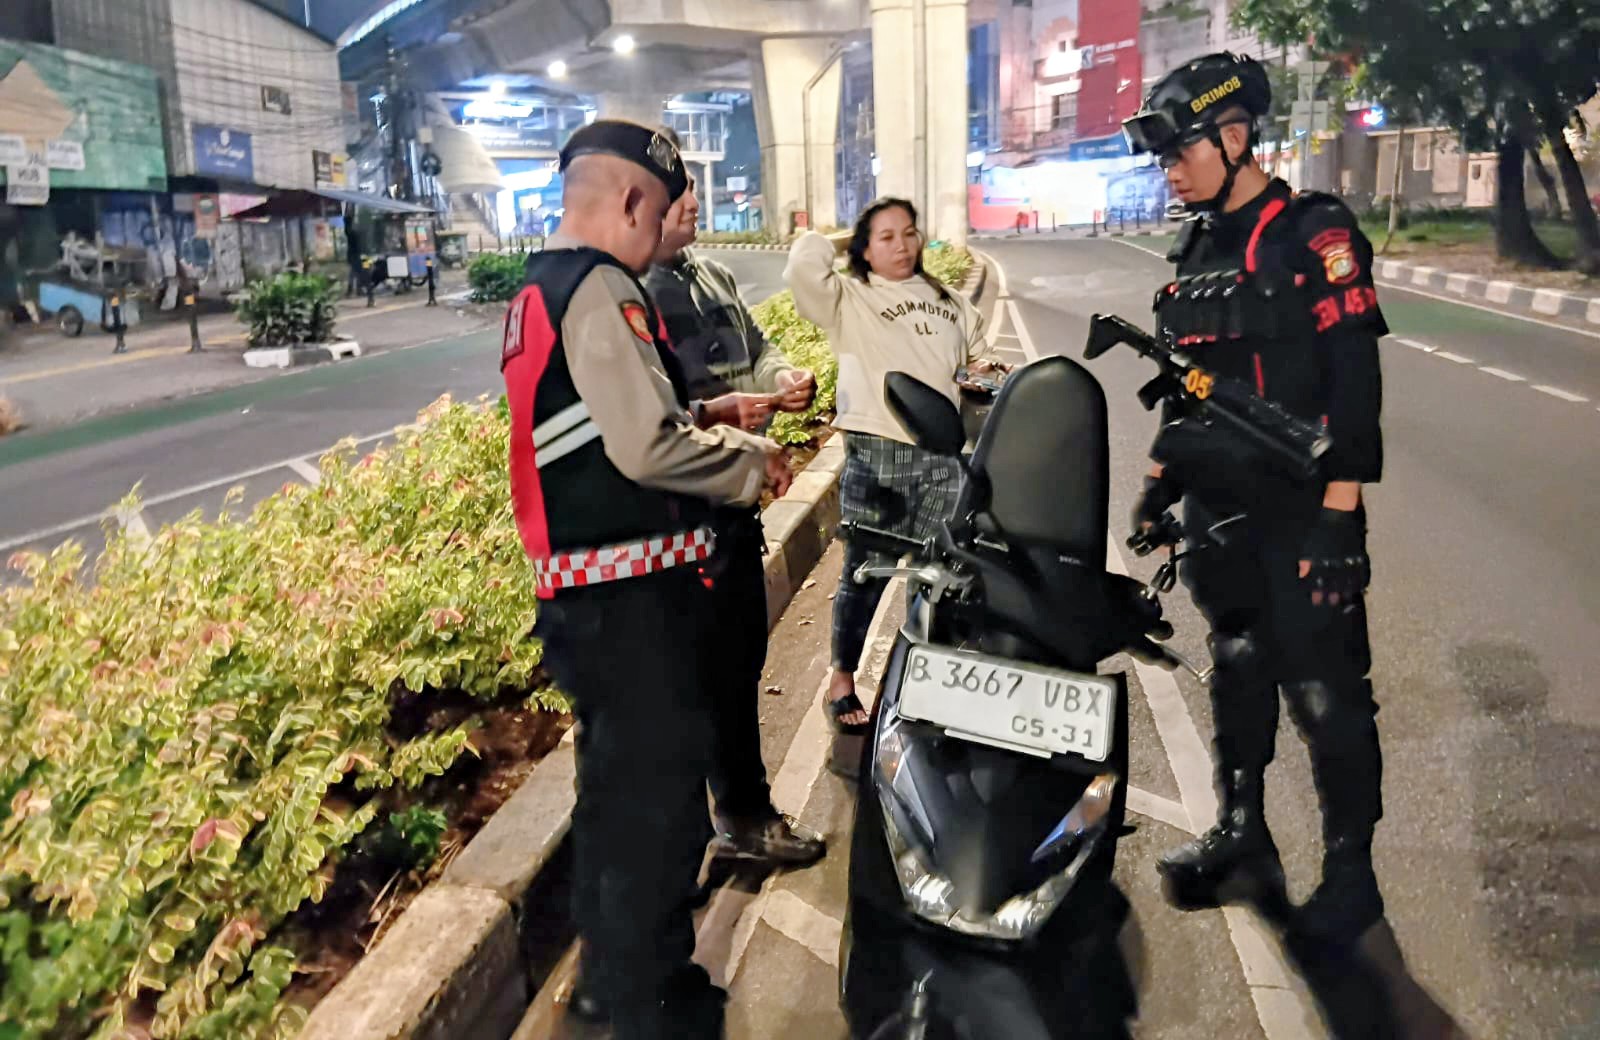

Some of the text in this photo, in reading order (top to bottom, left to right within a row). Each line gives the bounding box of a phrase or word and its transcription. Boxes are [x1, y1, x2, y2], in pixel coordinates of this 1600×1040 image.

[1190, 76, 1241, 113] BRIMOB
[1186, 369, 1211, 399] 05
[911, 655, 1100, 716] B 3667 VBX
